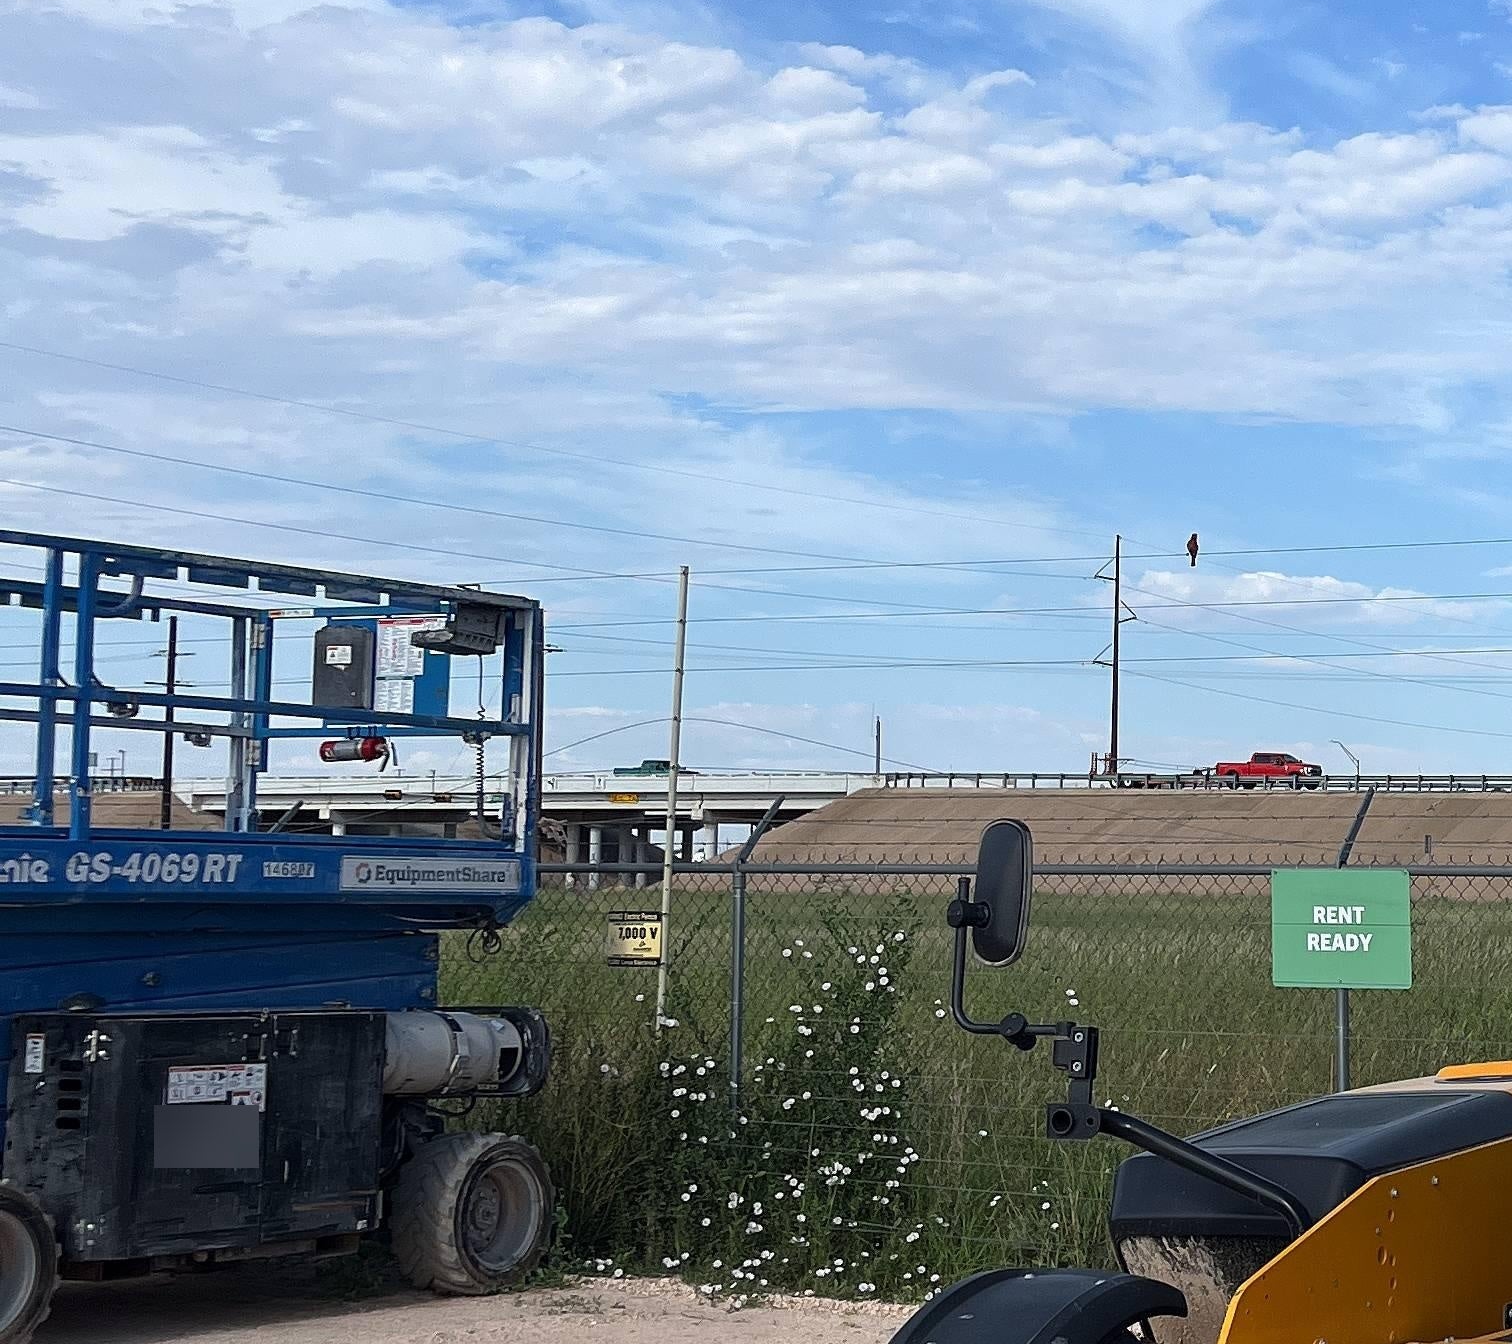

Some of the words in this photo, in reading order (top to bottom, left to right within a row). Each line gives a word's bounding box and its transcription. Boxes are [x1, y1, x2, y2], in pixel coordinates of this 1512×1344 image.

[0, 853, 49, 883] nie
[65, 851, 199, 883] GS-4069
[202, 854, 243, 883] RT
[375, 864, 506, 886] EquipmentShare
[1313, 906, 1364, 924] RENT
[618, 927, 647, 941] 7,000
[650, 927, 658, 939] V
[1307, 933, 1373, 952] READY
